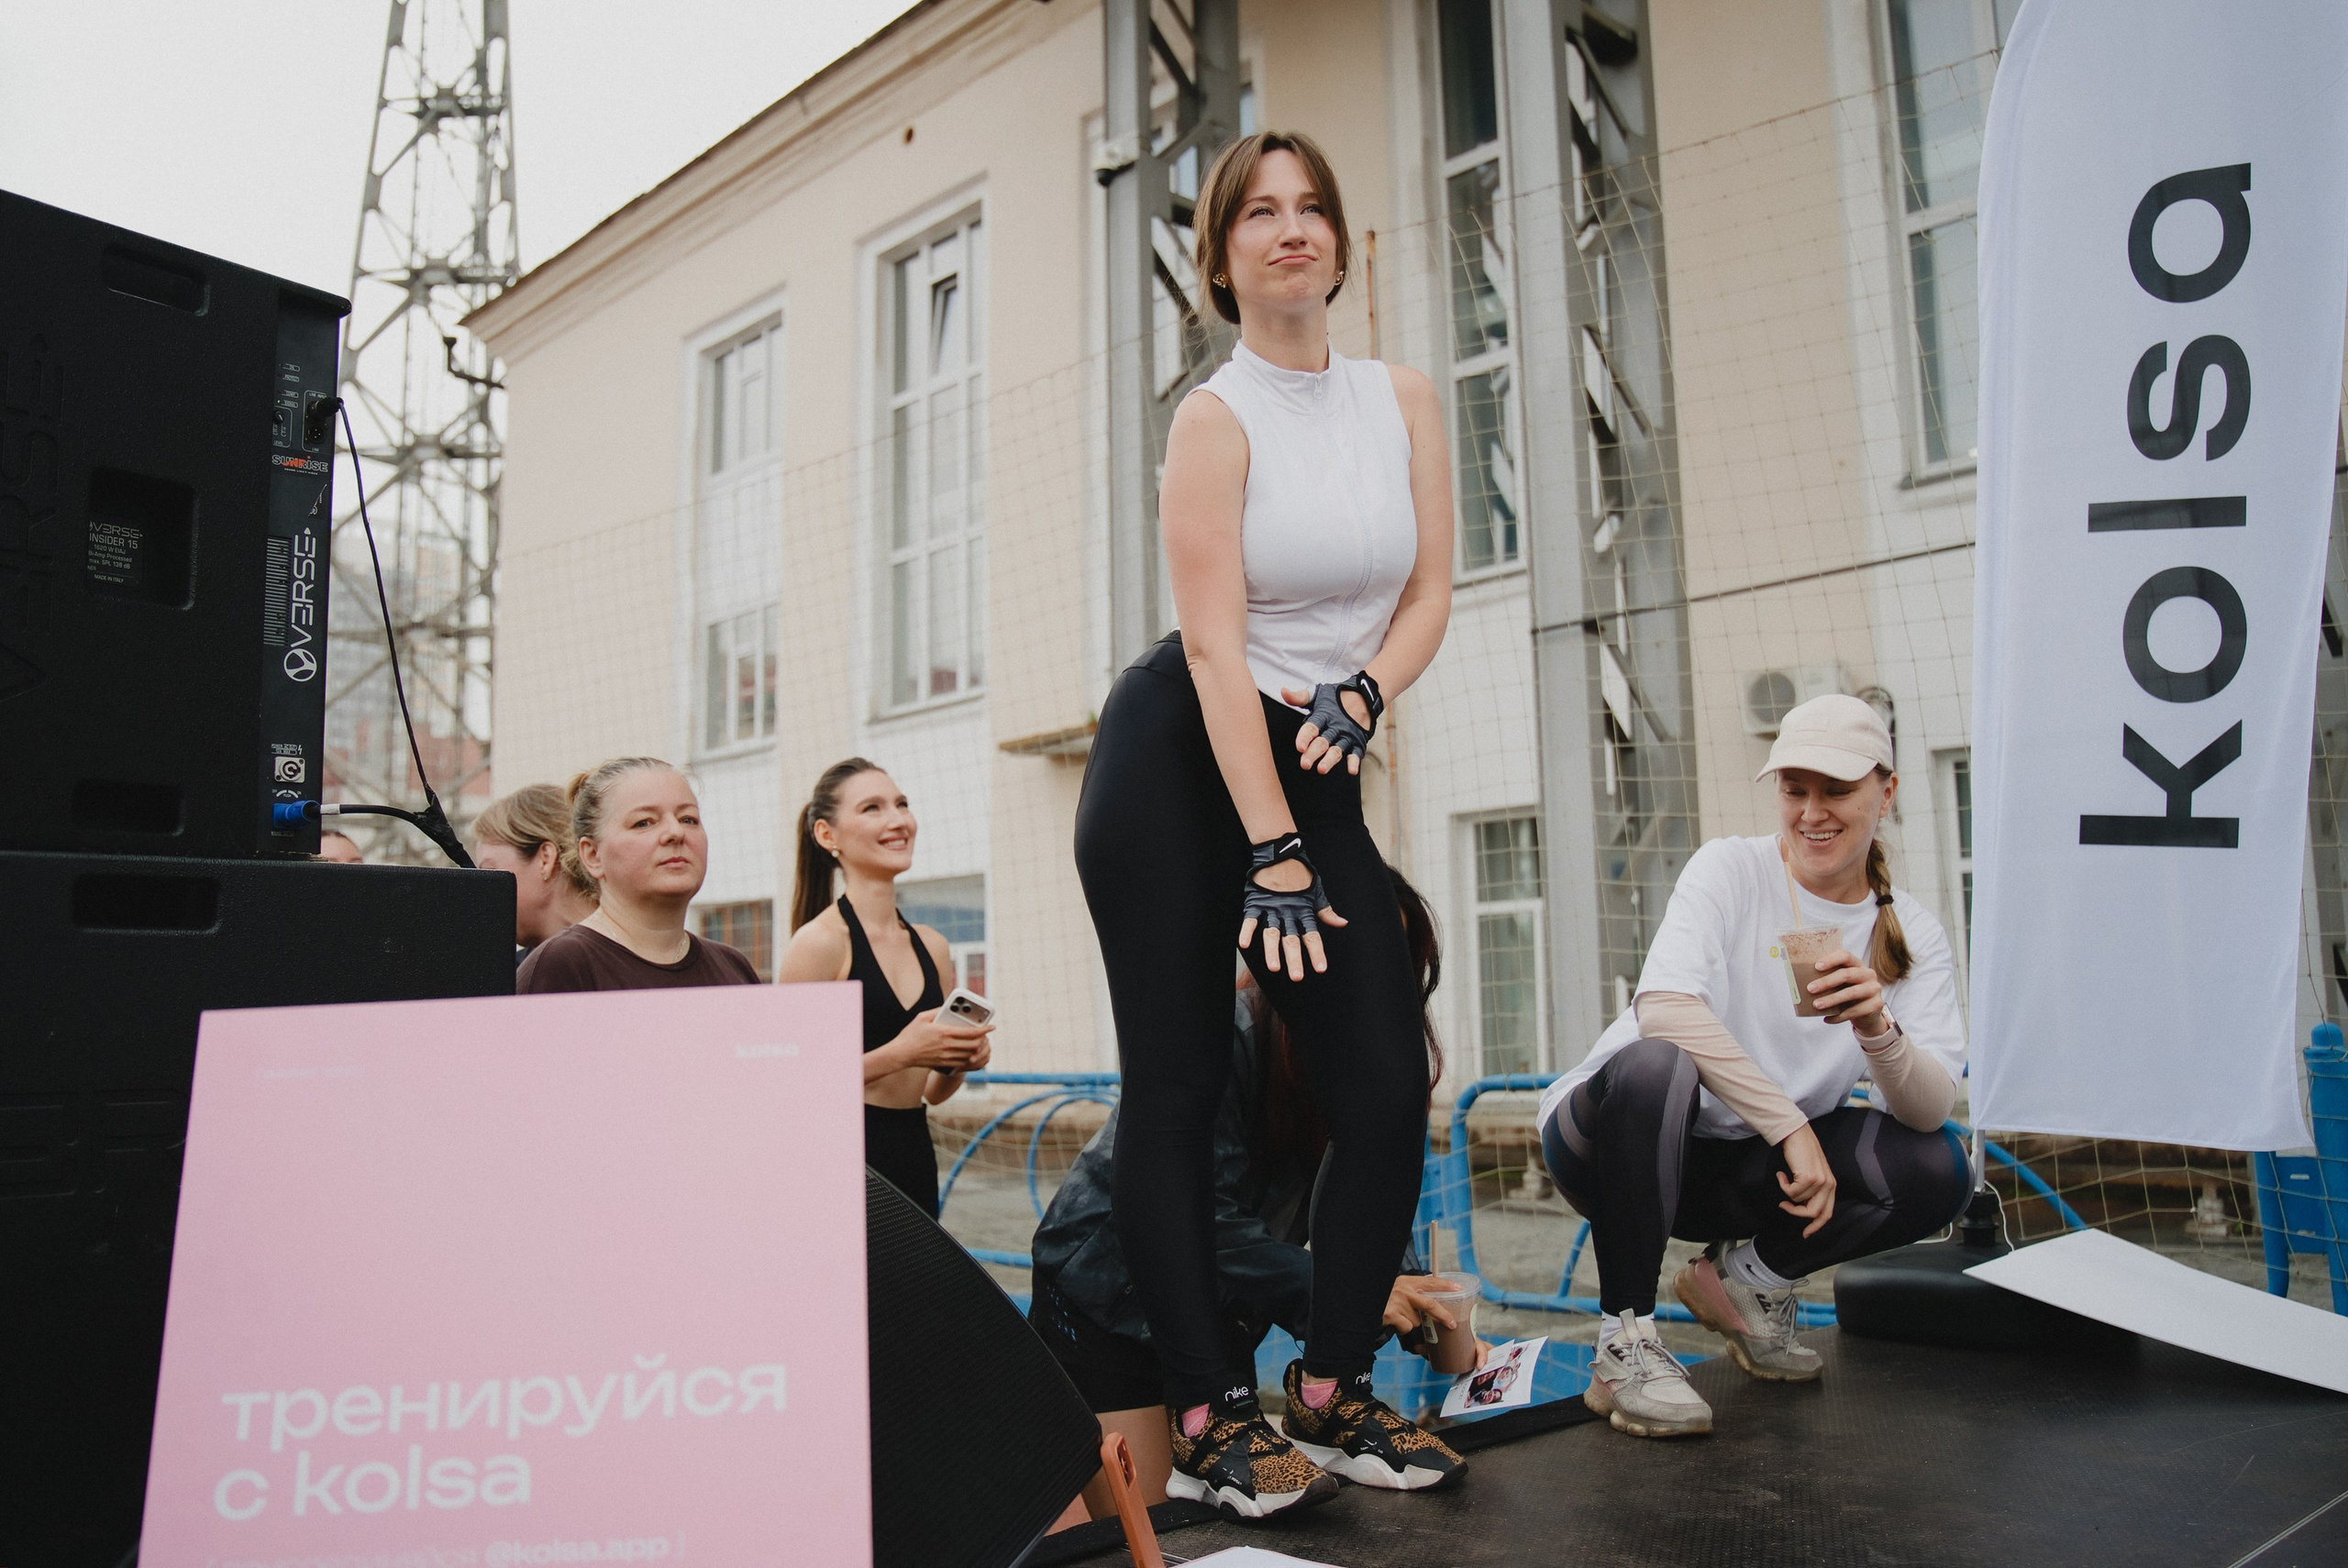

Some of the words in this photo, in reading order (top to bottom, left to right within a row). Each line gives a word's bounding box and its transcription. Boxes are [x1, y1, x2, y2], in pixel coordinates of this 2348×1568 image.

[271, 454, 328, 472] SUNRISE
[2079, 162, 2251, 848] kolsa
[89, 533, 125, 547] INSIDER
[127, 539, 138, 549] 15
[106, 553, 133, 563] Processed
[1355, 1371, 1371, 1386] nike
[221, 1352, 788, 1453] тренируйся
[1224, 1386, 1249, 1402] nike
[213, 1468, 270, 1522] с
[292, 1444, 532, 1518] kolsa
